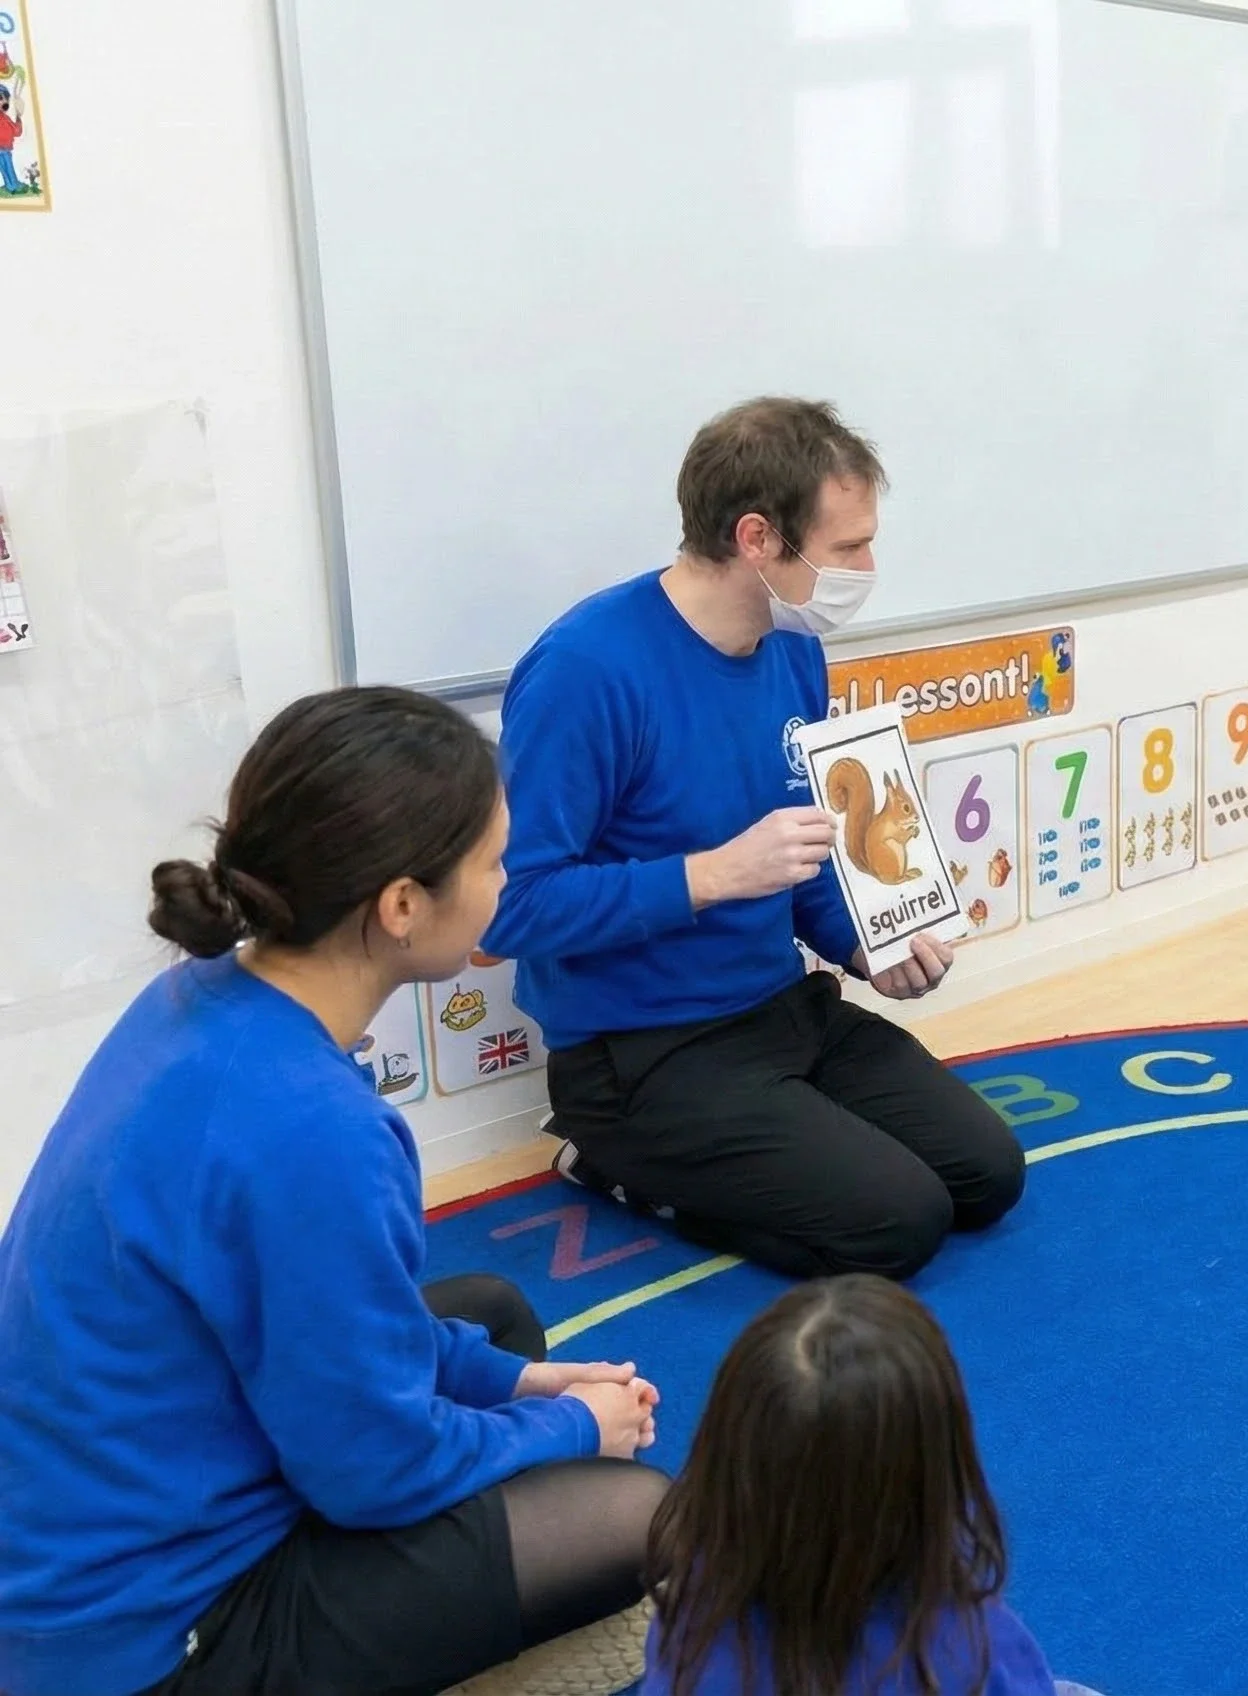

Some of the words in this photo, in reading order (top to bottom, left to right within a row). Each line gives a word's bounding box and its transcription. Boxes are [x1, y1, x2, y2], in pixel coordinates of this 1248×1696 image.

[1055, 751, 1088, 820] 7
[1142, 727, 1175, 794] 8
[954, 774, 991, 843] 6
[869, 880, 946, 936] squirrel
[968, 1074, 1080, 1127] B
[1121, 1050, 1233, 1095] C
[489, 1206, 661, 1280] Z
